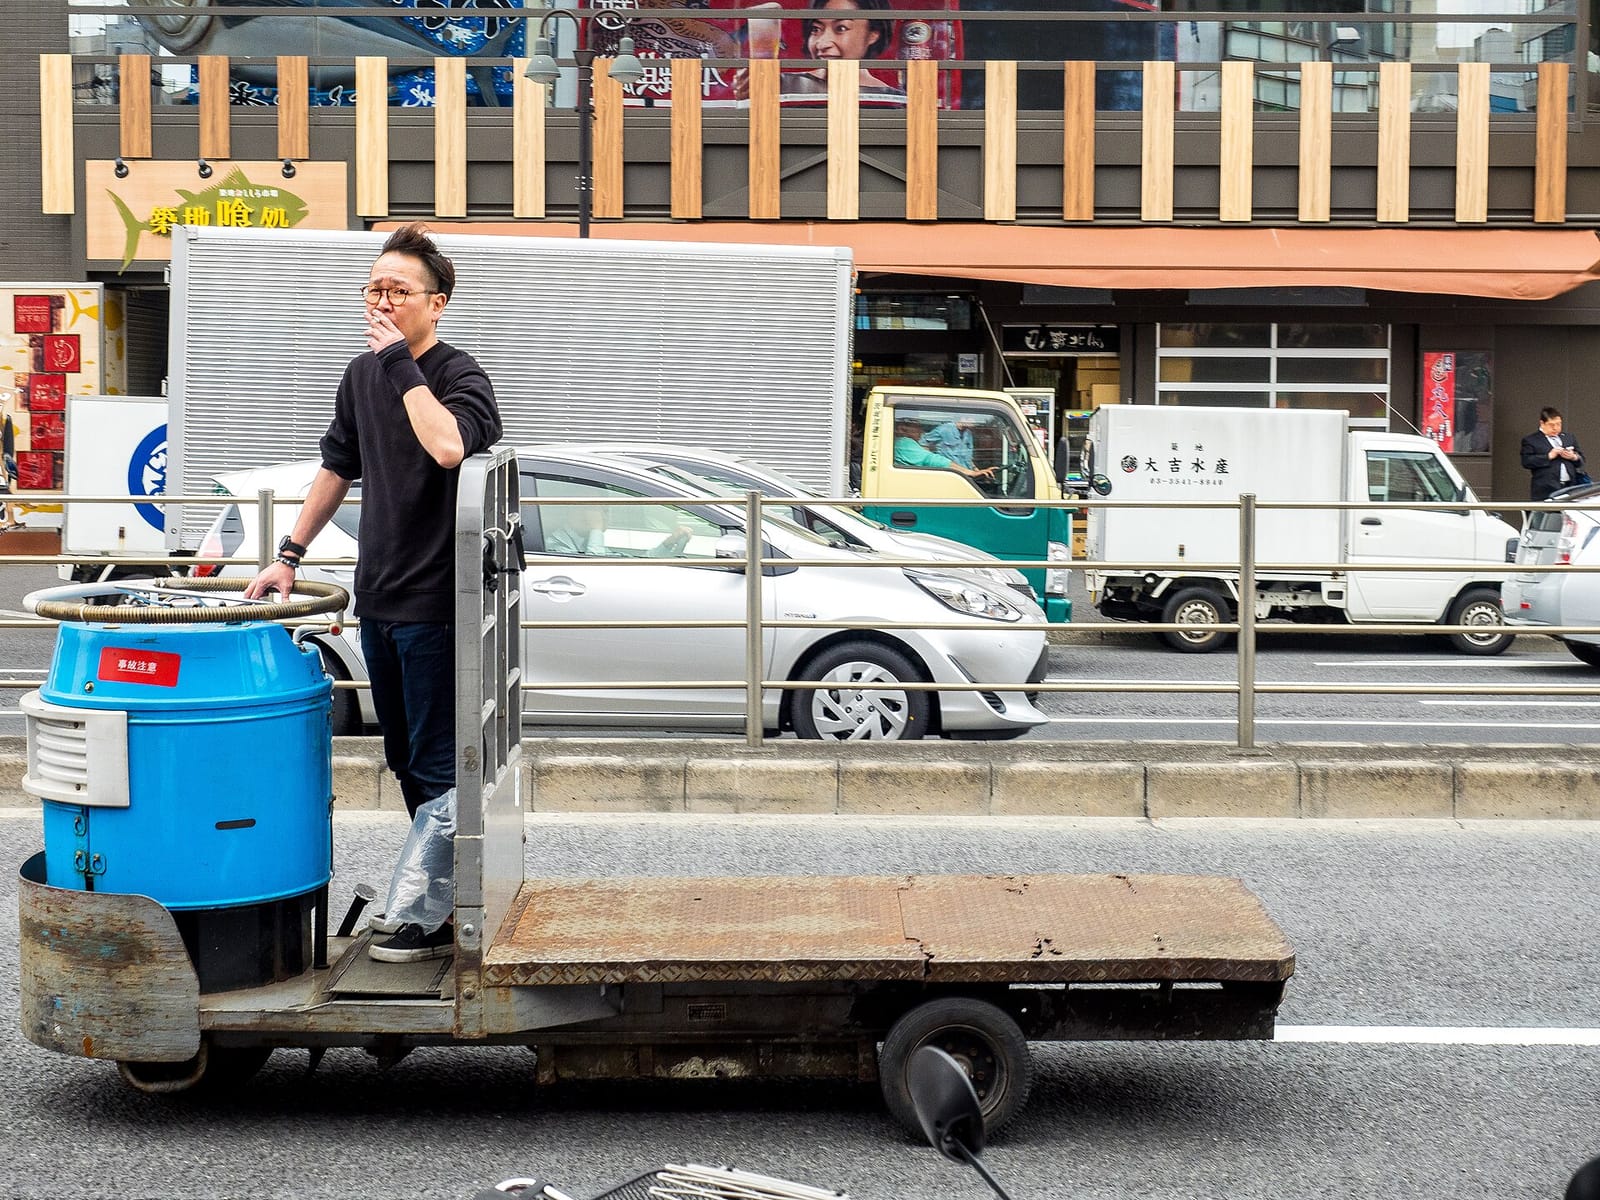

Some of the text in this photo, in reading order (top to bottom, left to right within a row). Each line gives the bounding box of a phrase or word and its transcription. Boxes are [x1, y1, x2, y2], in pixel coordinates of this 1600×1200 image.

[1144, 457, 1229, 474] 大吉水産
[117, 659, 158, 672] 事故注意
